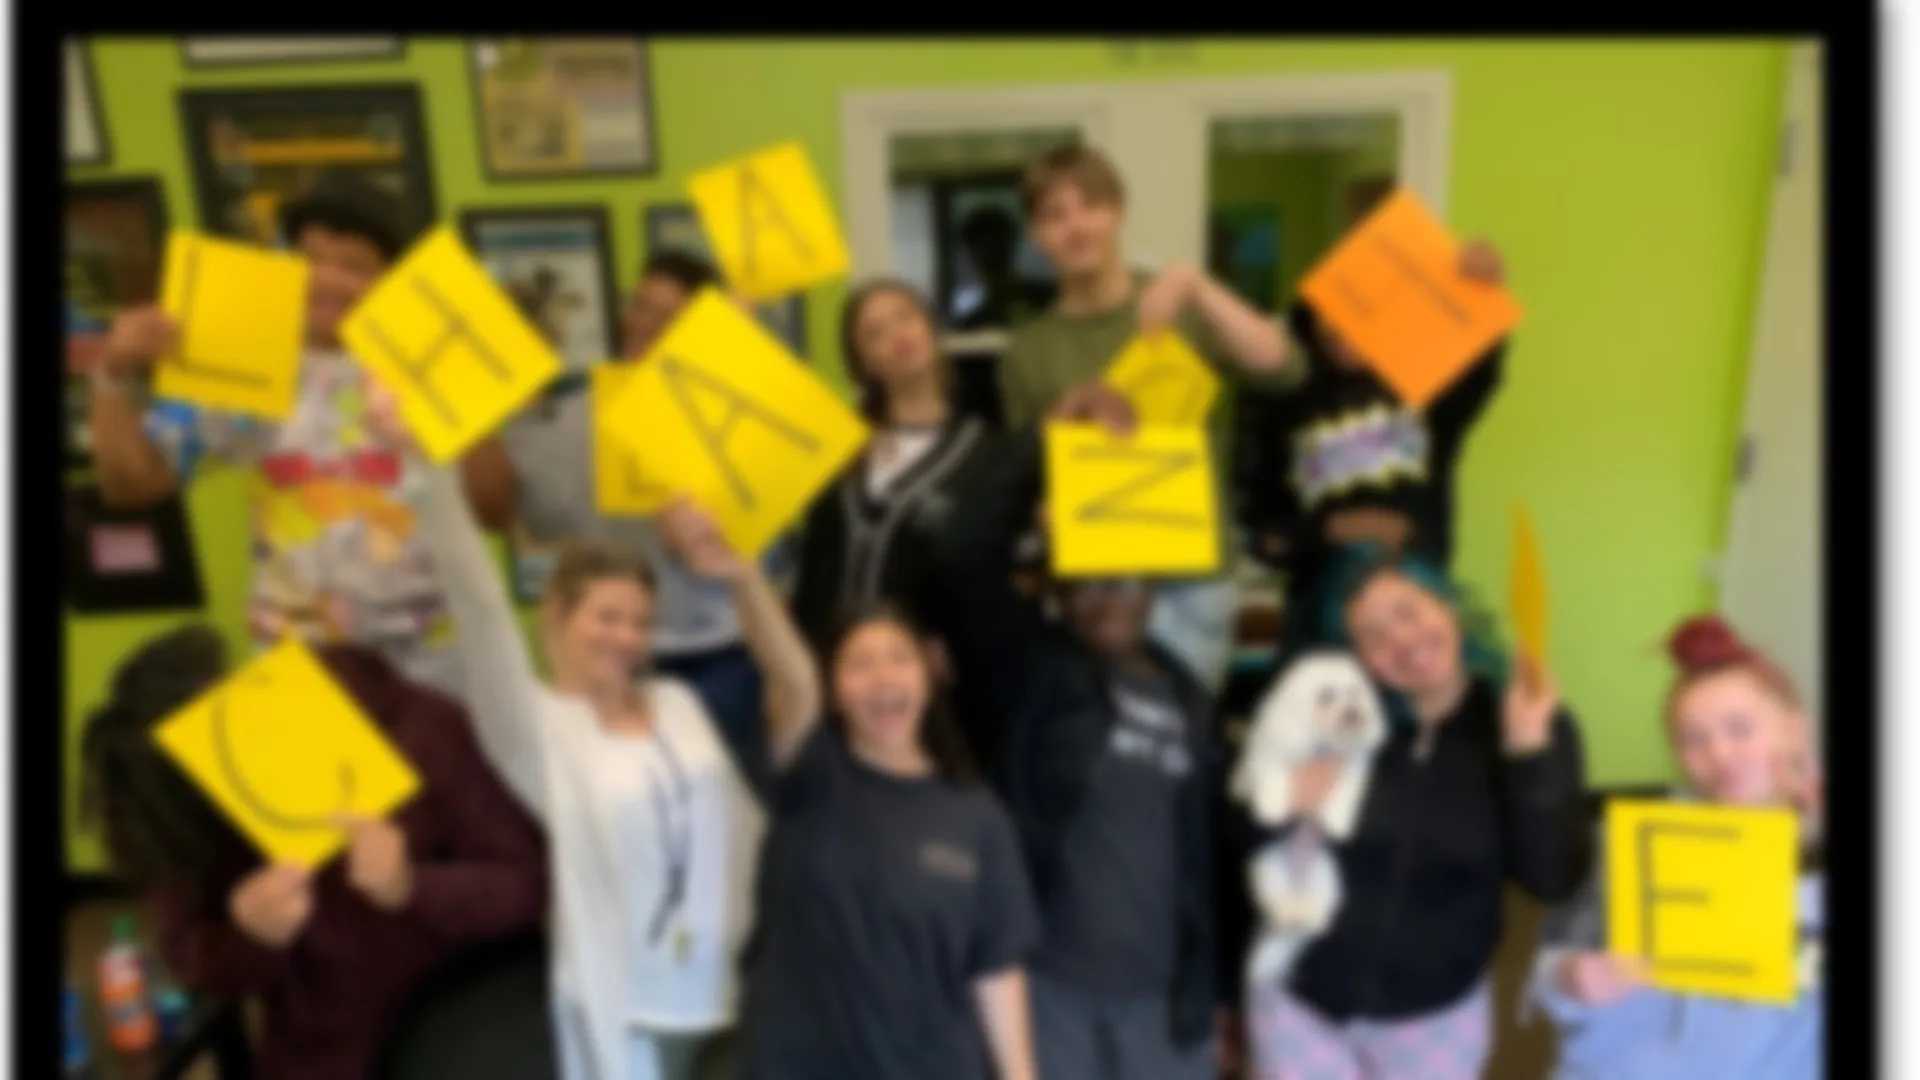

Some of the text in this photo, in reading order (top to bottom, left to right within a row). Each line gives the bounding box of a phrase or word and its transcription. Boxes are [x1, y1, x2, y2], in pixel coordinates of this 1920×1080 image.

[737, 166, 818, 284] A
[362, 272, 518, 430] H
[658, 352, 824, 514] A
[1634, 819, 1756, 978] E
